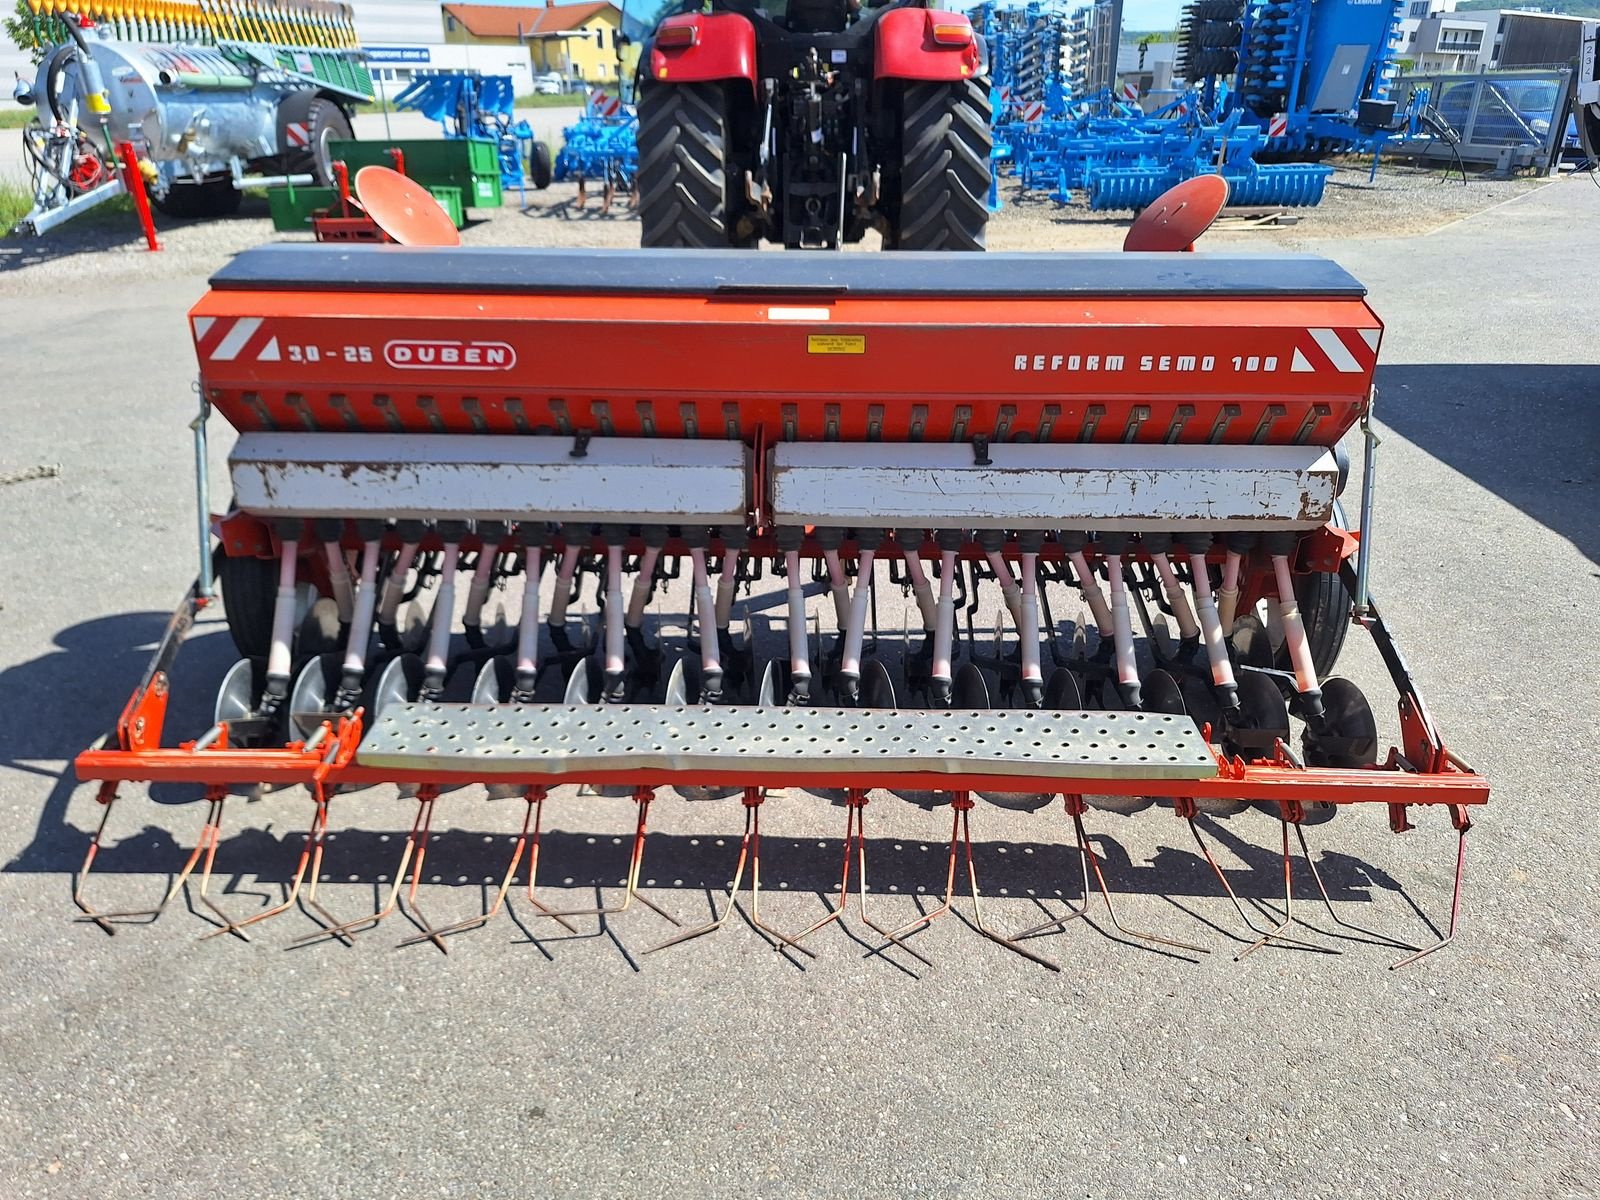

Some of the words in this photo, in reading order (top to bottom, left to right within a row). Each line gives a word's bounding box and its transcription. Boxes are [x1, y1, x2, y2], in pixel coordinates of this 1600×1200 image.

[343, 346, 373, 363] 25
[394, 346, 505, 364] DUBEN
[1013, 354, 1125, 371] REFORM
[1139, 355, 1216, 372] SEMO
[1231, 356, 1279, 372] 100
